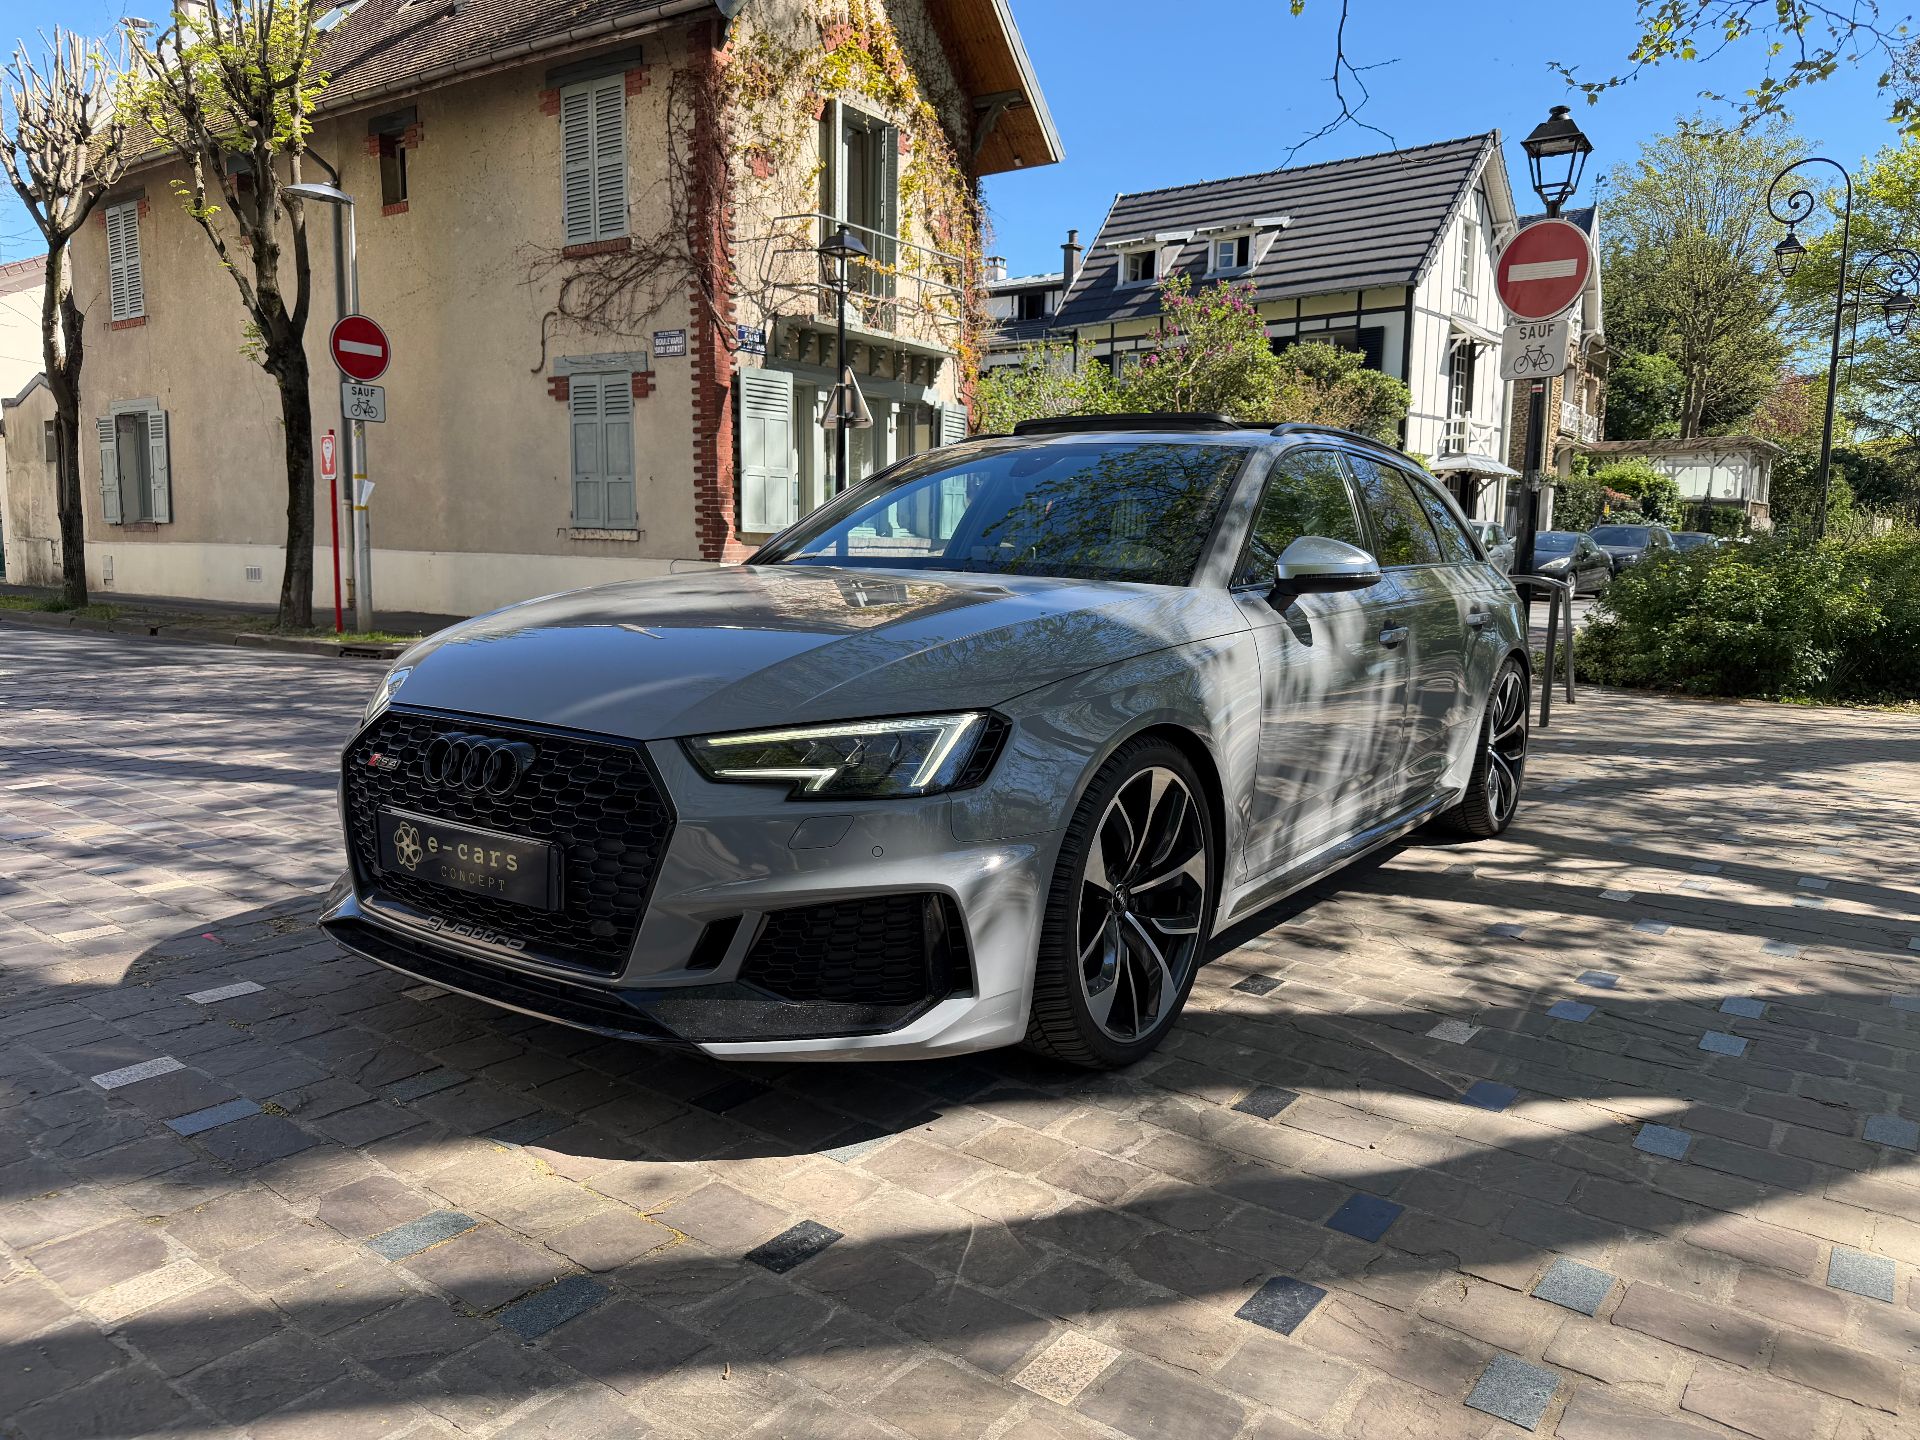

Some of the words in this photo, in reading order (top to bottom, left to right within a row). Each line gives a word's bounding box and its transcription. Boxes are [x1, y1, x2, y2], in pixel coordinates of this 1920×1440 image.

[1519, 324, 1555, 340] SAUF
[352, 387, 375, 397] SAUF
[368, 753, 400, 769] RS4
[427, 836, 519, 872] e-cars
[440, 865, 506, 892] CONCEPT
[428, 915, 526, 950] quattro
